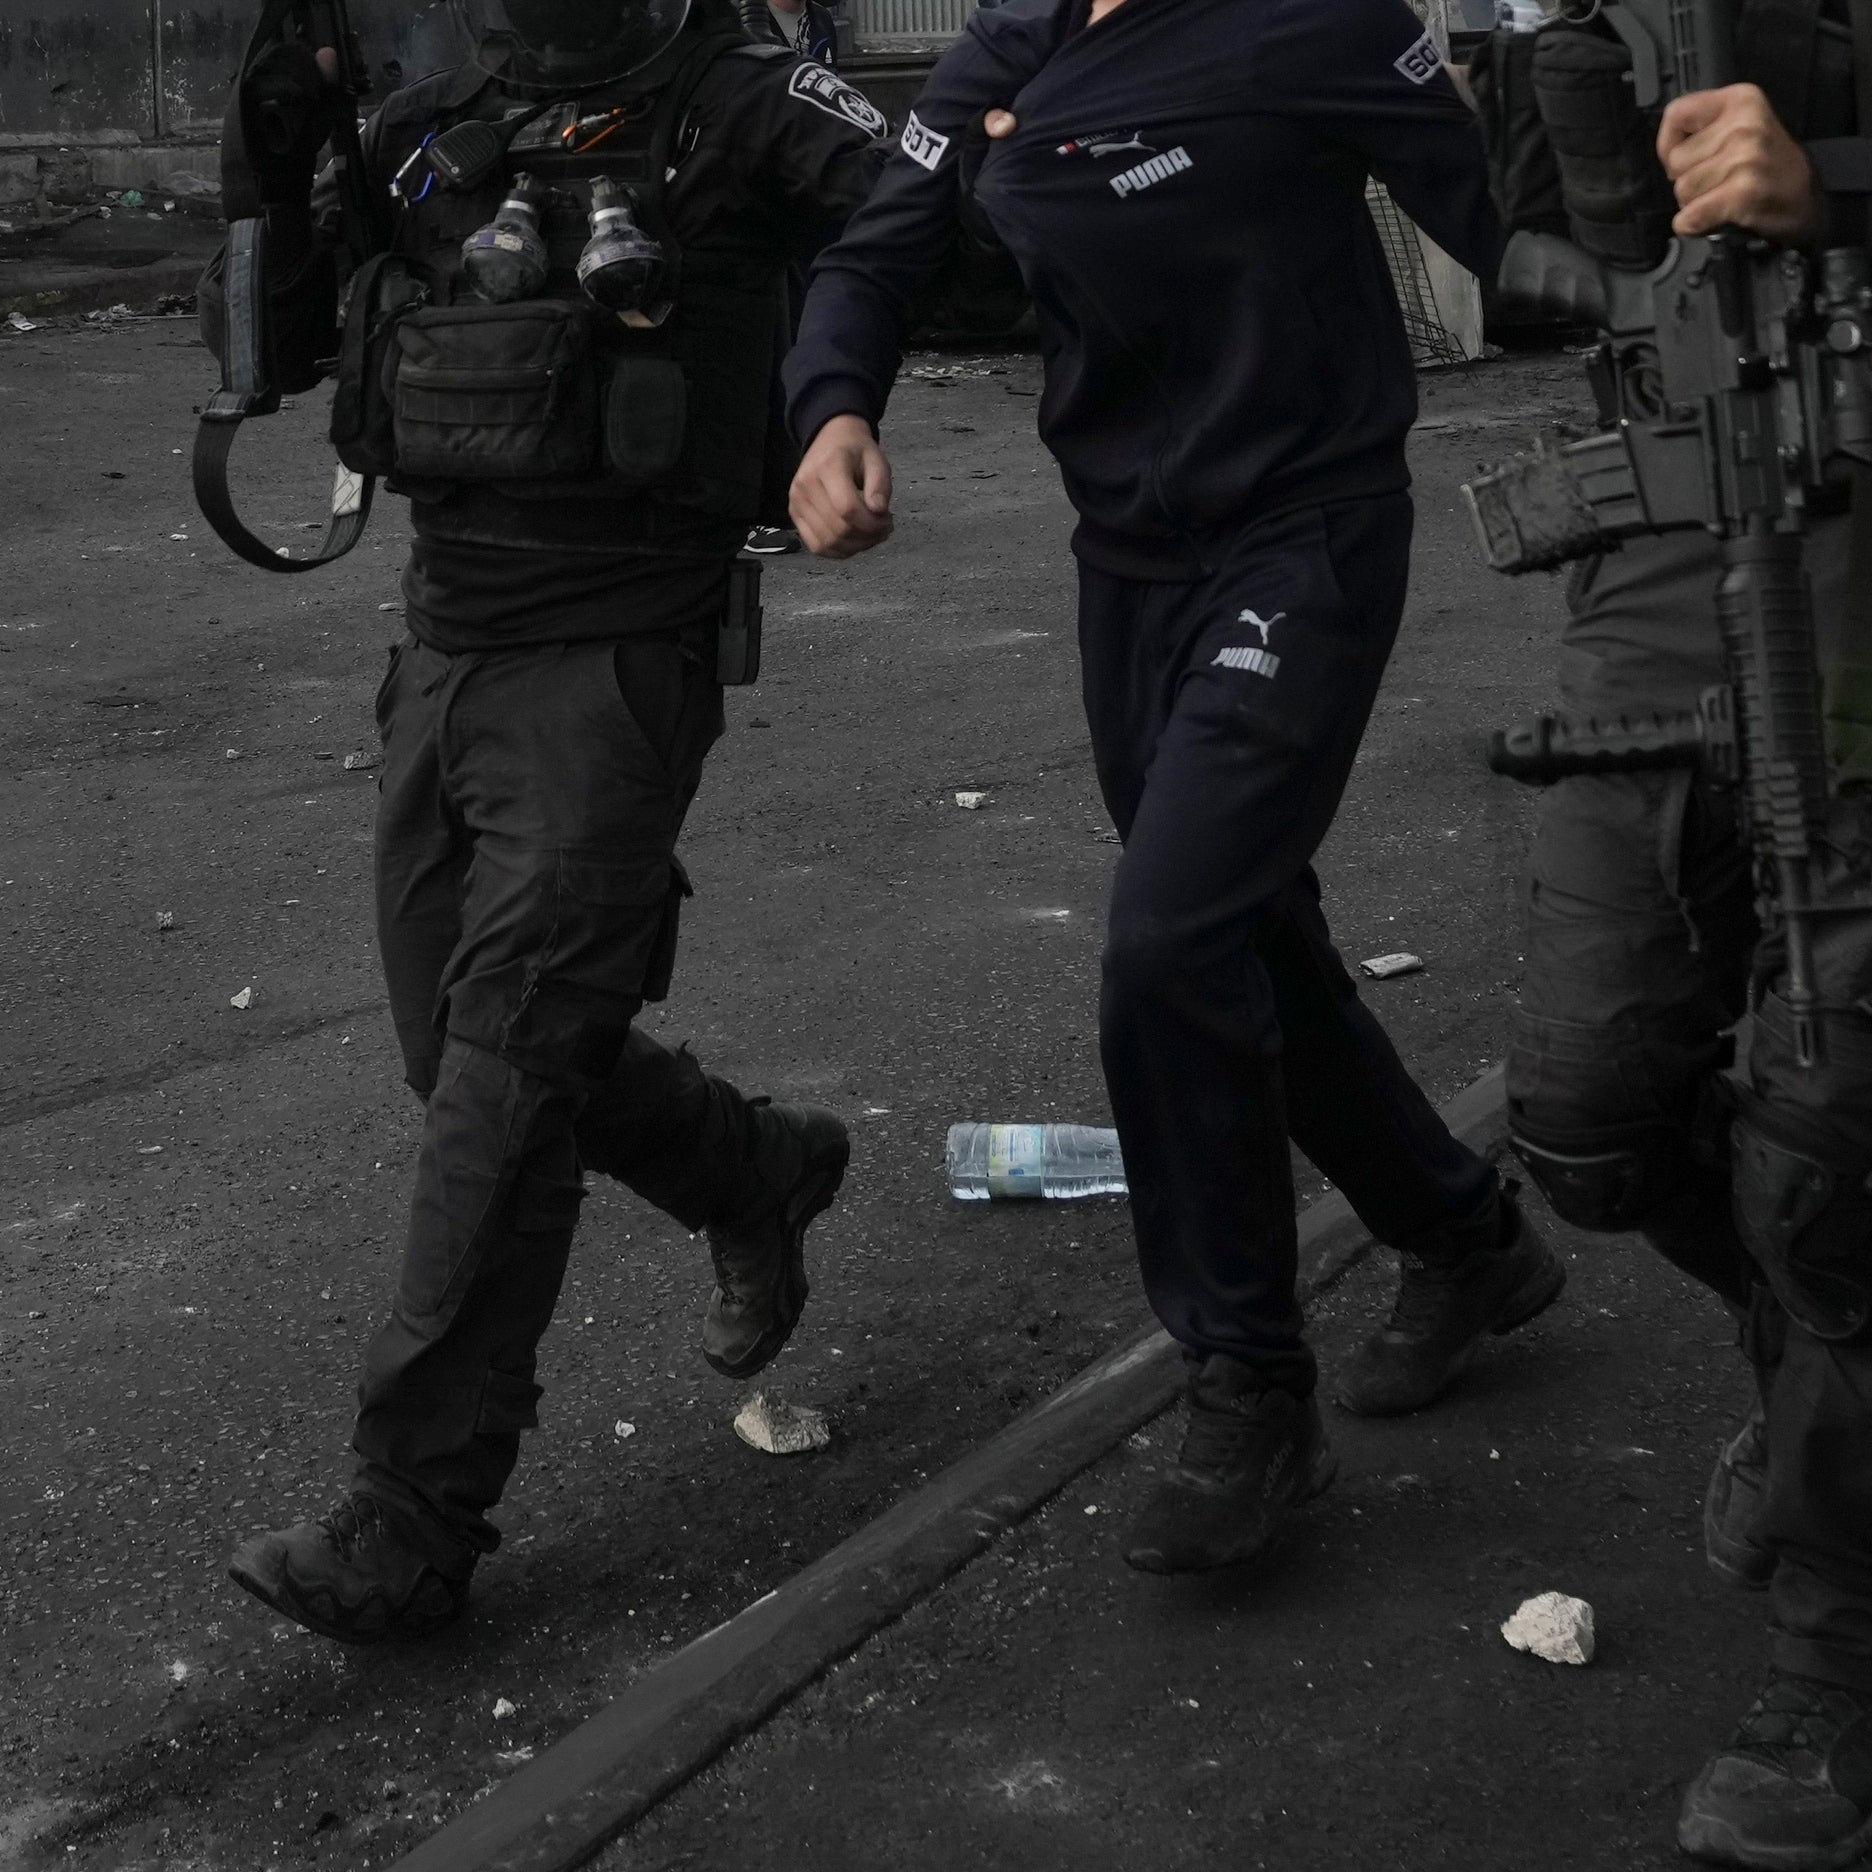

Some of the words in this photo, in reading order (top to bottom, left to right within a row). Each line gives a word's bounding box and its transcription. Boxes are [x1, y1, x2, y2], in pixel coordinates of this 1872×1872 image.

[1404, 37, 1440, 78] SO
[1109, 146, 1194, 199] PUMA
[1210, 647, 1281, 680] PUMA
